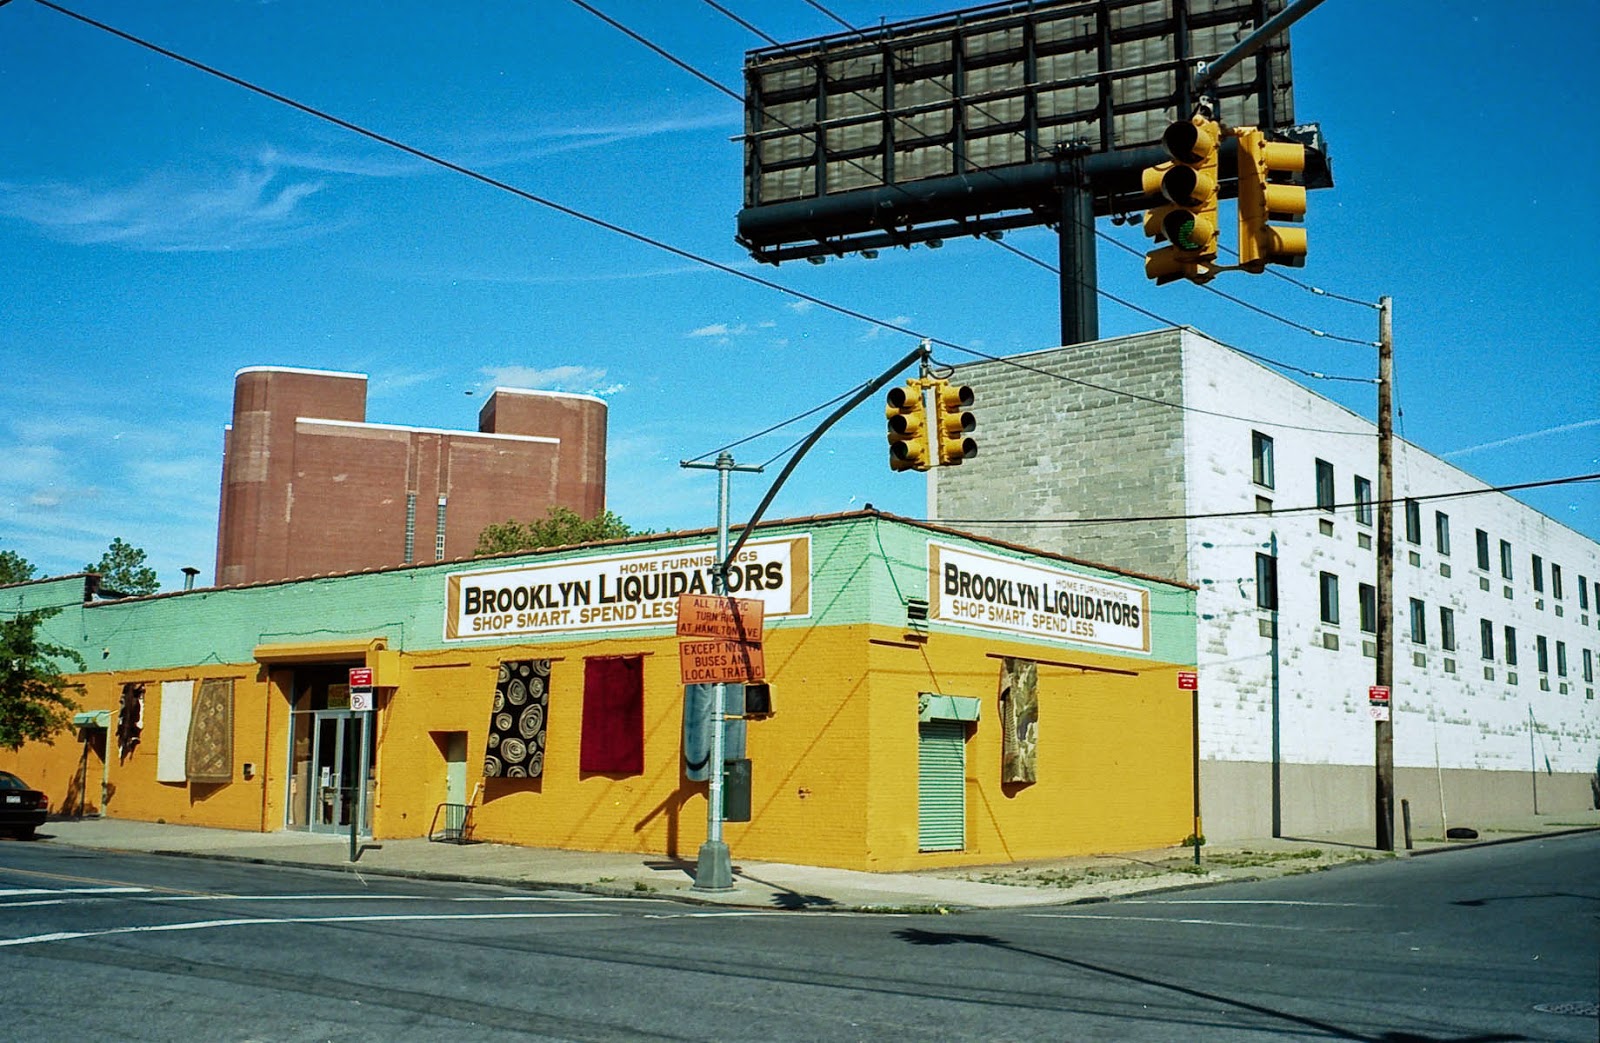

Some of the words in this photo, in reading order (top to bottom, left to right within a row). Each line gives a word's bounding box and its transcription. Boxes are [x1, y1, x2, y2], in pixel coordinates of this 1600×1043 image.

[620, 561, 657, 575] HOME
[661, 551, 758, 571] FURNISGS
[465, 582, 591, 615] BROOKLYN
[944, 563, 1040, 612] BROOKLYN
[1043, 583, 1140, 629] LIQUIDATORS
[1056, 580, 1078, 591] HOME
[1080, 583, 1128, 602] FURNISHINGS
[694, 599, 710, 609] ALL
[715, 600, 749, 612] TRAFIC
[472, 614, 514, 632] SHOP
[516, 610, 575, 629] SMART.
[579, 604, 636, 624] SPEND
[696, 611, 718, 621] TURN
[720, 613, 745, 623] RIGT
[952, 600, 986, 618] SHOP
[988, 605, 1029, 628] SMART.
[1032, 613, 1067, 633] SPEND
[1070, 618, 1097, 638] LESS.
[680, 623, 693, 633] AT
[694, 625, 737, 636] HAMILTON
[684, 643, 721, 656] EXCEPT
[695, 655, 727, 667] BUSES
[731, 654, 749, 665] AN
[685, 668, 717, 680] LOCAL
[722, 666, 761, 679] TRAFIC
